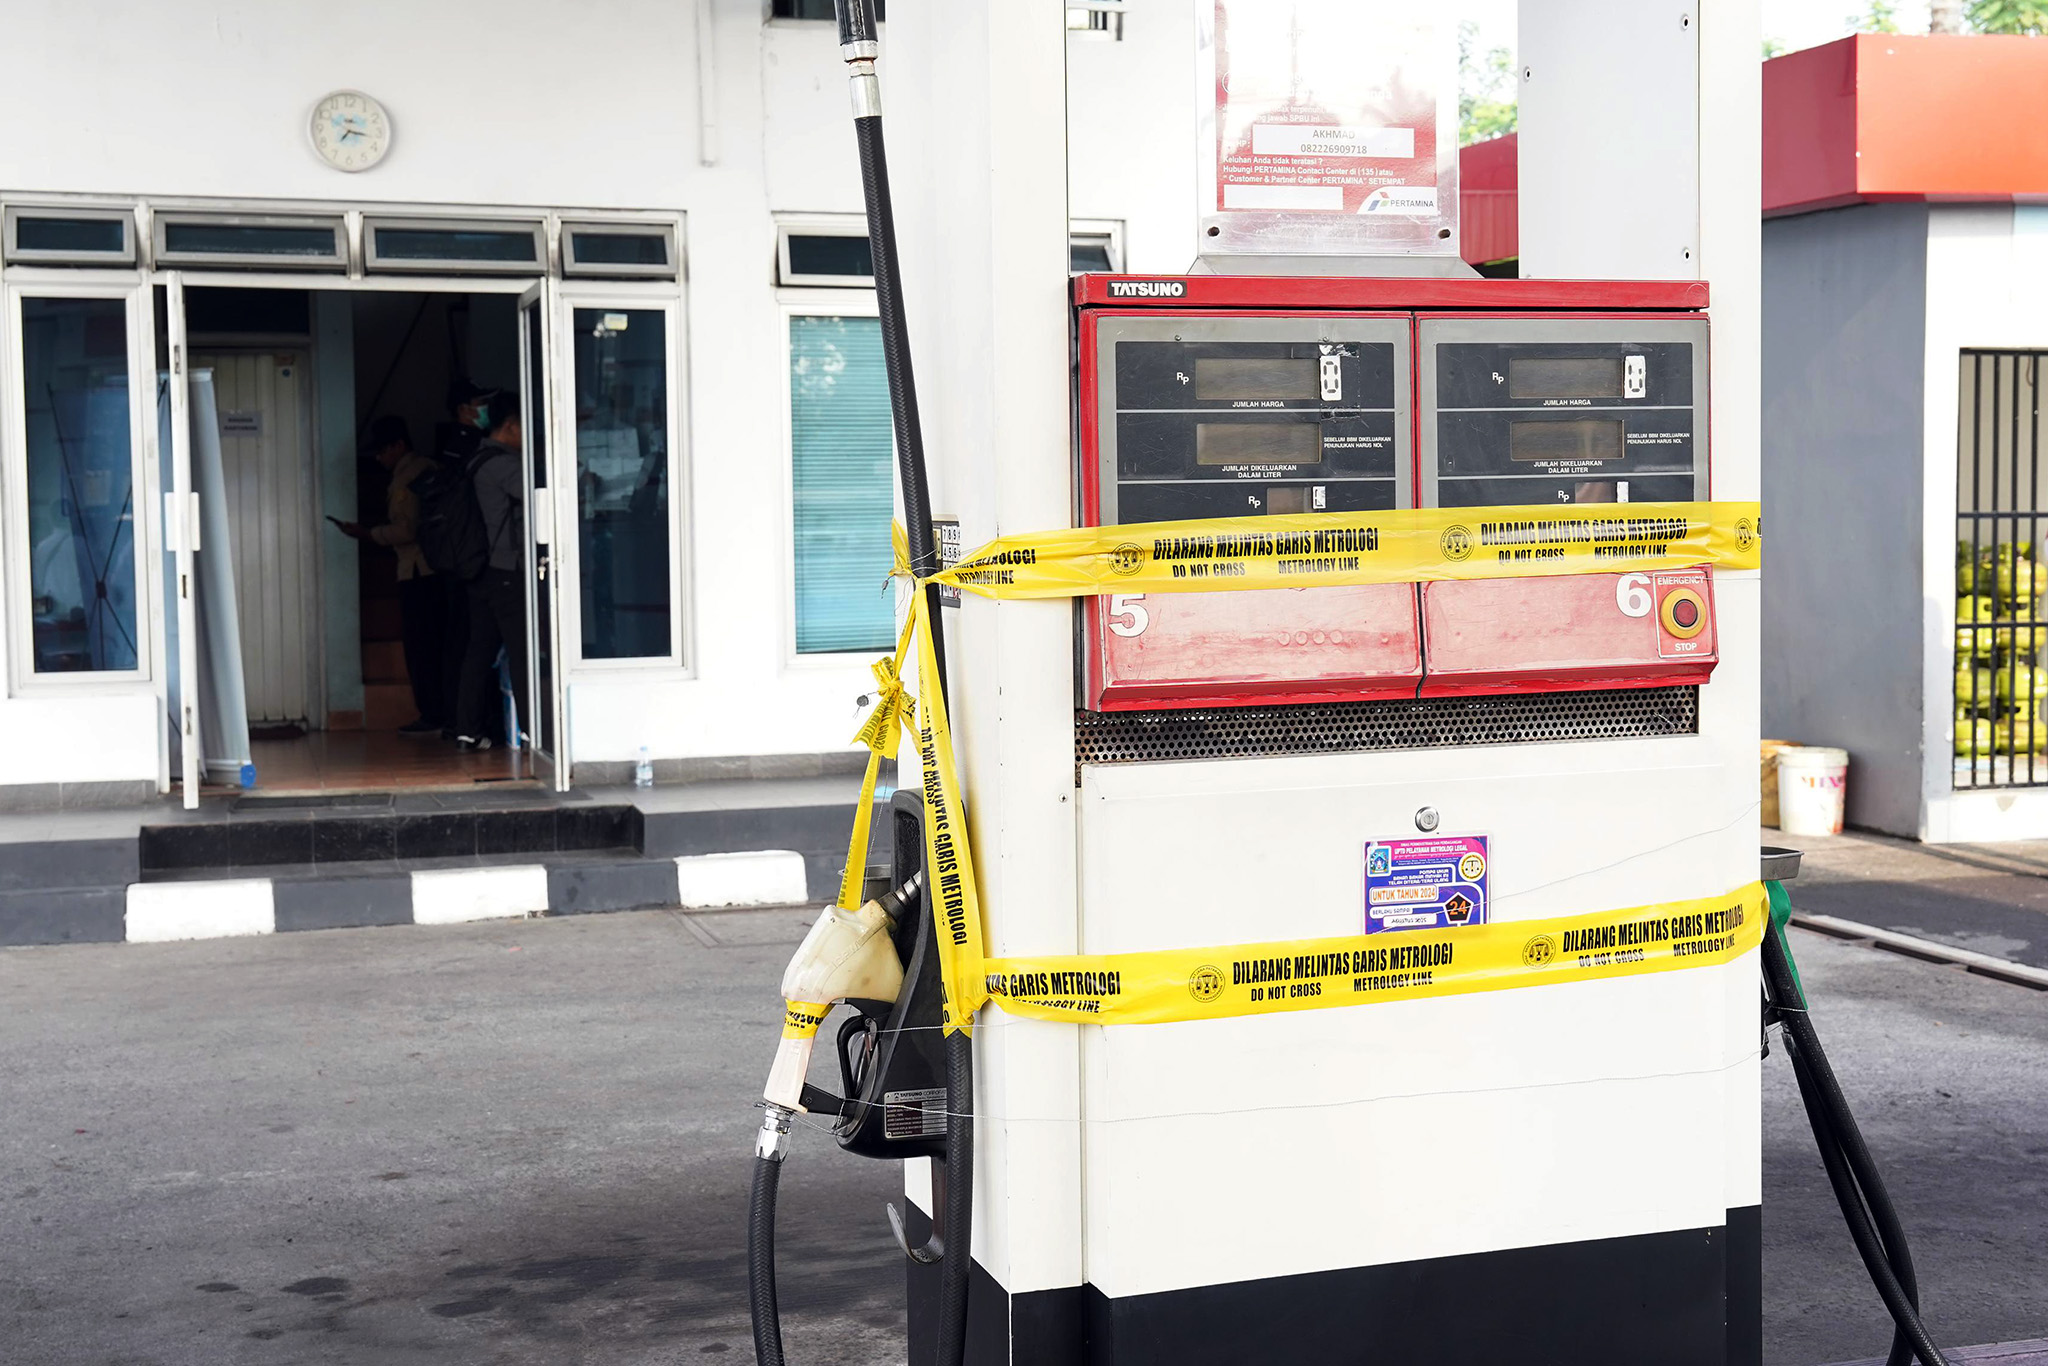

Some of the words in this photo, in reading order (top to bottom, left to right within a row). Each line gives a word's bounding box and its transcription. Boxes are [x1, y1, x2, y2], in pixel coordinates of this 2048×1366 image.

[1312, 130, 1355, 139] AKHMAD
[1300, 143, 1367, 155] 082226909718
[1223, 156, 1252, 164] Keluhan
[1253, 156, 1272, 164] Anda
[1272, 156, 1289, 164] tidak
[1291, 157, 1317, 165] teratasi
[1319, 157, 1323, 165] ?
[1223, 165, 1252, 174] Hubungi
[1254, 166, 1296, 174] PERTAMINA
[1297, 166, 1324, 174] Contact
[1325, 167, 1348, 175] Center
[1228, 174, 1263, 183] Customer
[1264, 175, 1270, 183] &
[1271, 175, 1296, 183] Partner
[1298, 176, 1320, 184] Center
[1368, 177, 1406, 185] SETEMPAT
[1111, 282, 1184, 297] TATSUNO
[1250, 464, 1297, 472] DIKELUARKAN
[1481, 522, 1536, 546] DILARANG
[1537, 519, 1591, 543] MELINTAS
[1593, 518, 1625, 542] GARIS
[1627, 517, 1688, 541] METROLOGI
[1153, 536, 1214, 560] DILARANG
[1215, 531, 1273, 557] MELINTAS
[1275, 529, 1311, 556] GARIS
[1313, 527, 1379, 553] METROLOGI
[1498, 550, 1511, 564] DO
[1514, 549, 1532, 563] NOT
[1535, 547, 1565, 562] CROSS
[1594, 545, 1646, 561] METROLOGY
[1648, 544, 1667, 558] LINE
[1172, 564, 1187, 578] DO
[1190, 563, 1209, 577] NOT
[1213, 561, 1246, 577] CROSS
[1278, 557, 1336, 574] METROLOGY
[1338, 556, 1360, 571] LINE
[1657, 575, 1705, 586] EMERGENCY
[1616, 572, 1652, 617] 6
[1108, 593, 1149, 637] 5
[1675, 642, 1697, 652] STOP
[936, 833, 958, 873] GARIS
[1372, 889, 1395, 901] UNTUK
[1397, 888, 1419, 900] TAHUN
[1420, 887, 1436, 898] 2024
[940, 872, 967, 945] METROLOGI
[1449, 900, 1468, 915] 24
[1563, 927, 1616, 953] DILARANG
[1618, 920, 1669, 946] MELINTAS
[1671, 914, 1702, 940] GARIS
[1704, 904, 1744, 935] METROLOGI
[1578, 955, 1591, 967] DO
[1594, 952, 1612, 965] NOT
[1615, 949, 1644, 963] CROSS
[1673, 937, 1725, 957] METROLOGY
[1725, 934, 1735, 949] LINE
[1233, 957, 1291, 985] DILARANG
[1294, 951, 1350, 978] MELINTAS
[1352, 946, 1387, 974] GARIS
[1390, 942, 1453, 970] METROLOGI
[1010, 972, 1049, 997] GARIS
[1050, 971, 1120, 996] METROLOGI
[1250, 988, 1264, 1001] DO
[1268, 985, 1287, 1000] NOT
[1290, 982, 1322, 998] CROSS
[1353, 973, 1410, 992] METROLOGY
[1412, 971, 1433, 986] LINE
[1076, 1000, 1100, 1013] LINE
